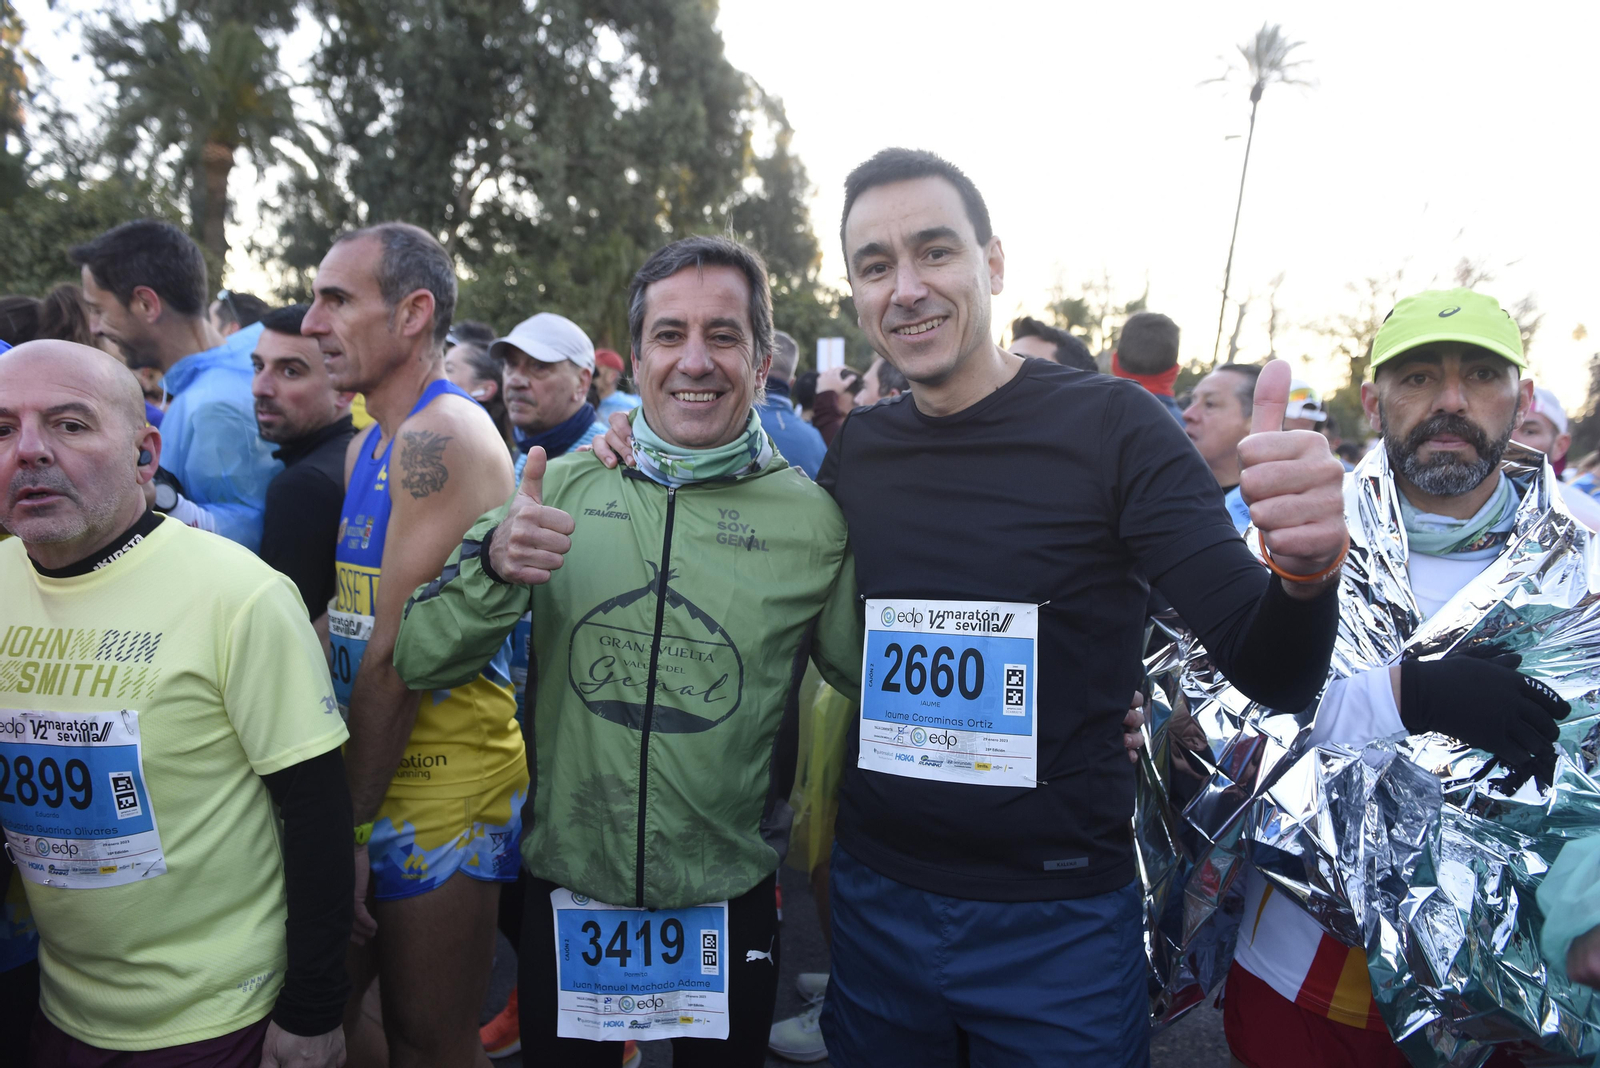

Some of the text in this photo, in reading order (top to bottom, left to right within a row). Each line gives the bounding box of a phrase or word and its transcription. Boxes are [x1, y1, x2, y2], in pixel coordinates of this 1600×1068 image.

[717, 508, 740, 520] YO
[717, 521, 750, 534] SOY
[897, 607, 923, 628] edp
[943, 609, 1000, 622] maratón
[955, 619, 1001, 632] sevilla
[0, 626, 162, 663] JOHN RUN
[600, 636, 714, 663] GRAN VUELTA
[623, 660, 686, 674] VALLE DEL
[881, 642, 985, 700] 2660
[16, 661, 118, 697] SMITH
[578, 655, 729, 703] Genal
[1523, 676, 1558, 703] KIPSTA
[920, 700, 941, 708] JAUME
[0, 717, 25, 738] edp
[44, 720, 98, 733] maratón
[884, 710, 993, 729] Jaume Corominas Ortiz
[58, 731, 100, 742] sevilla
[929, 730, 957, 749] edp
[398, 753, 447, 769] otion
[895, 753, 915, 762] HOKA
[0, 754, 93, 811] 2899
[394, 769, 431, 780] unning
[35, 811, 60, 819] Eduardo
[36, 823, 72, 835] Guarino
[75, 827, 119, 836] Olivares
[52, 840, 79, 858] edp
[28, 861, 45, 872] HOKA
[581, 918, 685, 968] 3419
[573, 979, 711, 992] Juan Manuel Machado Adame
[637, 995, 664, 1011] edp
[603, 1020, 624, 1028] HOKA
